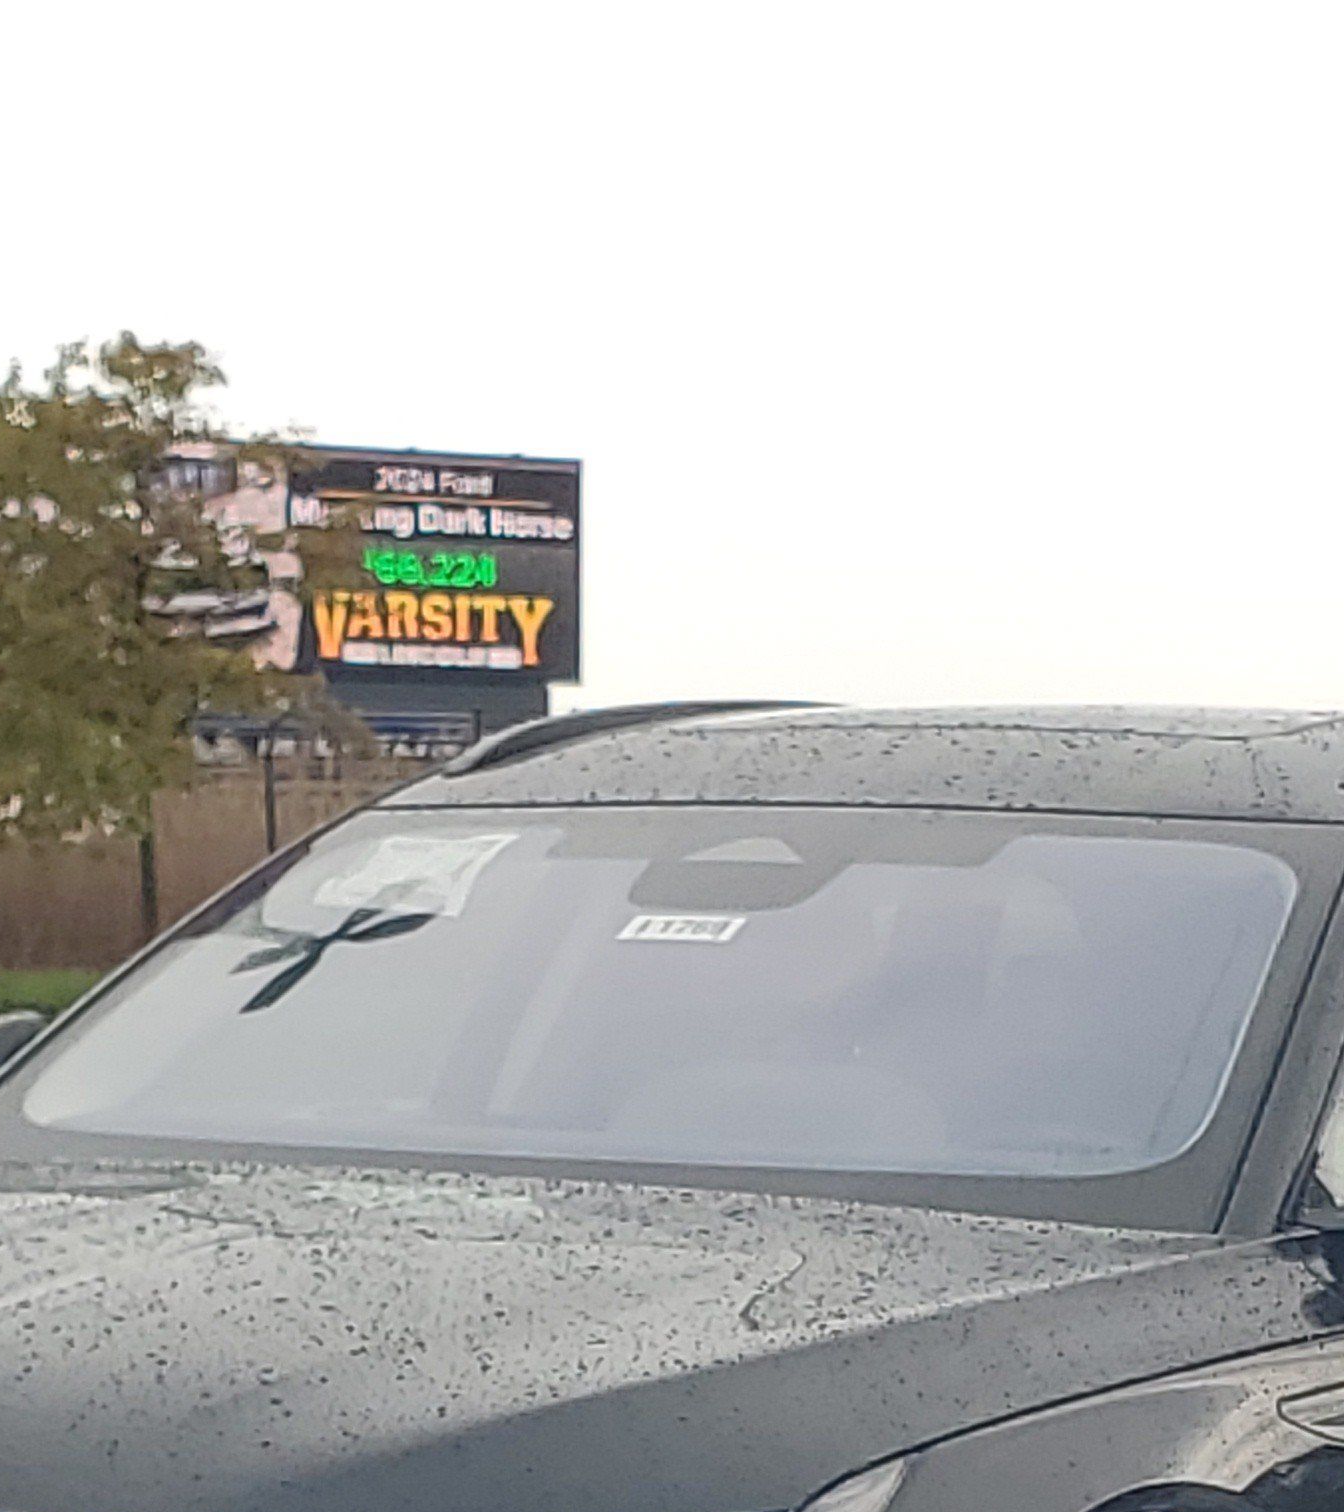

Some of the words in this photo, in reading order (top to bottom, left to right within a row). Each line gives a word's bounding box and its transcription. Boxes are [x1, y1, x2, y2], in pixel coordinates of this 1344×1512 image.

[417, 503, 487, 535] Dark
[490, 507, 575, 539] Horse
[313, 588, 554, 667] VARSITY
